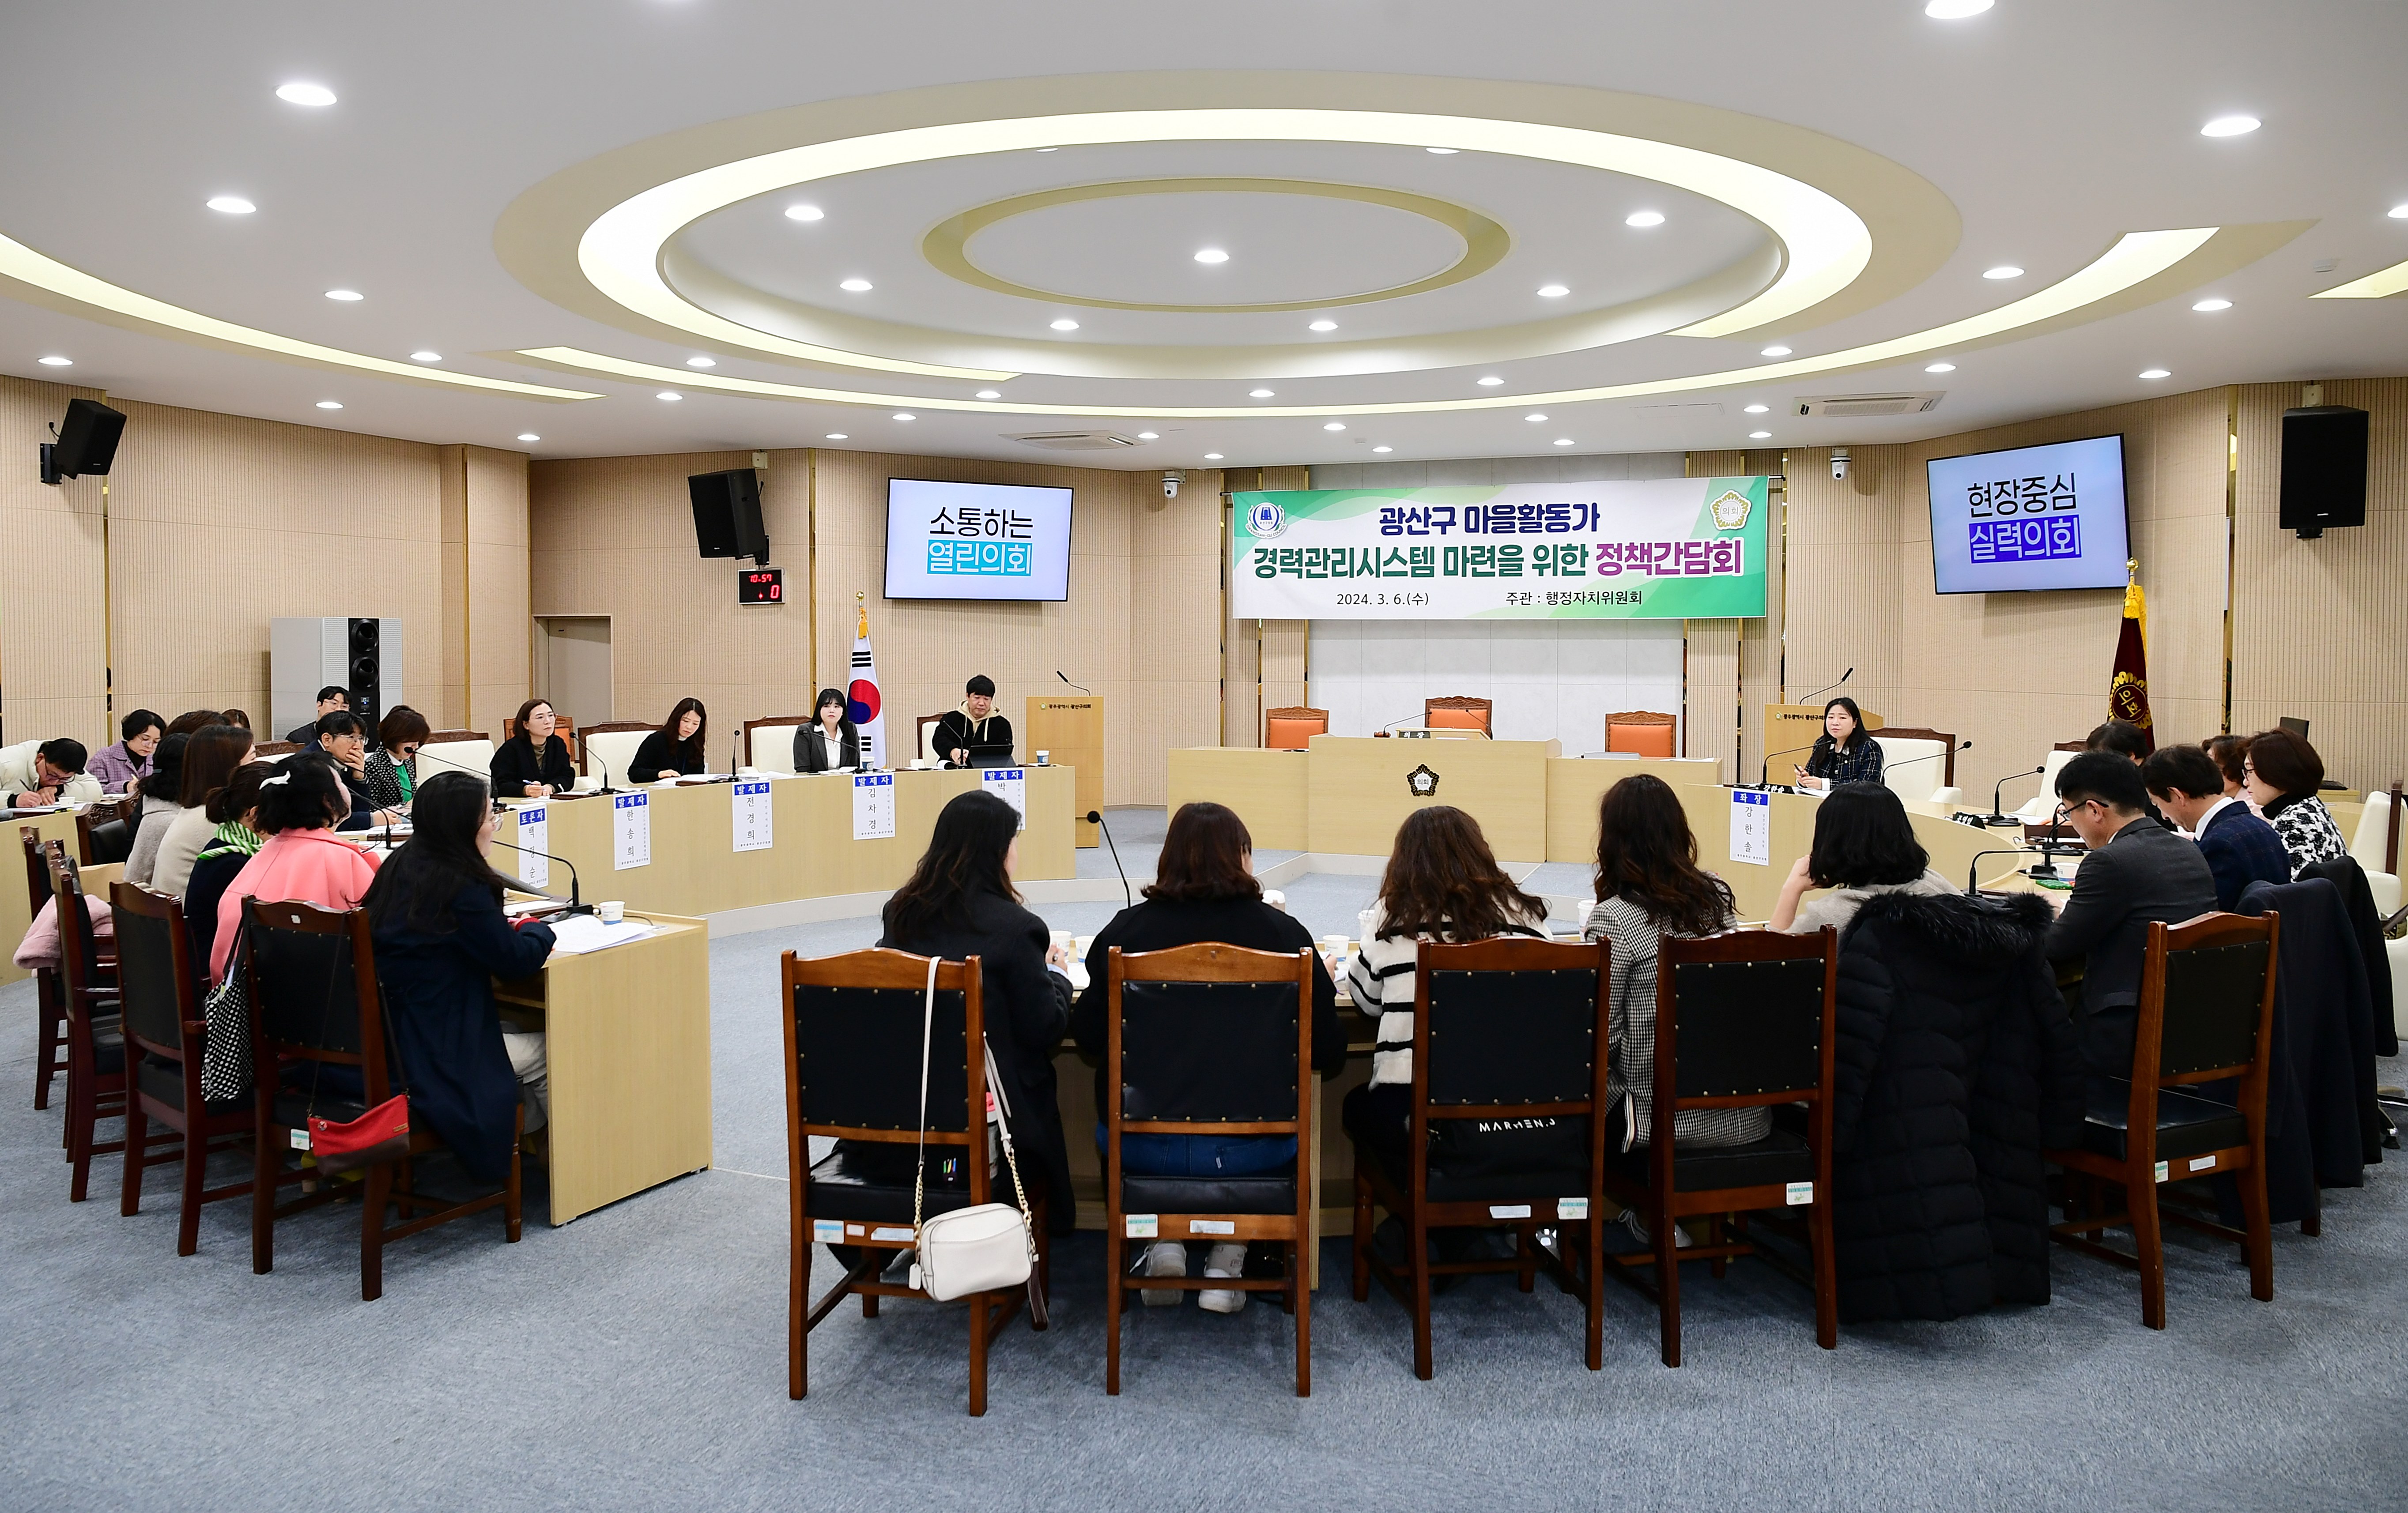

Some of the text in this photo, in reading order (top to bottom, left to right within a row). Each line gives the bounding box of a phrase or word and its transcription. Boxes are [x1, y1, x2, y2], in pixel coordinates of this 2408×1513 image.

[1967, 473, 2076, 517] 현장중심
[1379, 502, 1600, 535] 광산구 마을활동가
[1722, 507, 1738, 516] 의회
[929, 507, 1033, 538] 소통하는
[1971, 517, 2080, 561] 실력의회
[929, 542, 1031, 574] 열린의회
[1254, 540, 1741, 578] 경력관리시스템 마련을 위한 정책간담회
[770, 585, 779, 598] 0
[1336, 593, 1428, 606] 2024. 3. 6.(수)
[1506, 591, 1532, 606] 주관
[1546, 590, 1642, 606] 행정자치위원회
[2119, 690, 2141, 717] 의회
[858, 775, 889, 786] 발제자
[988, 771, 1020, 780] 발제자
[737, 783, 766, 795] 발제자
[618, 795, 645, 808] 발제자
[1740, 793, 1762, 805] 좌장
[521, 809, 543, 824] 토론자
[868, 788, 877, 829] 김차경
[1744, 806, 1753, 853] 강한솔
